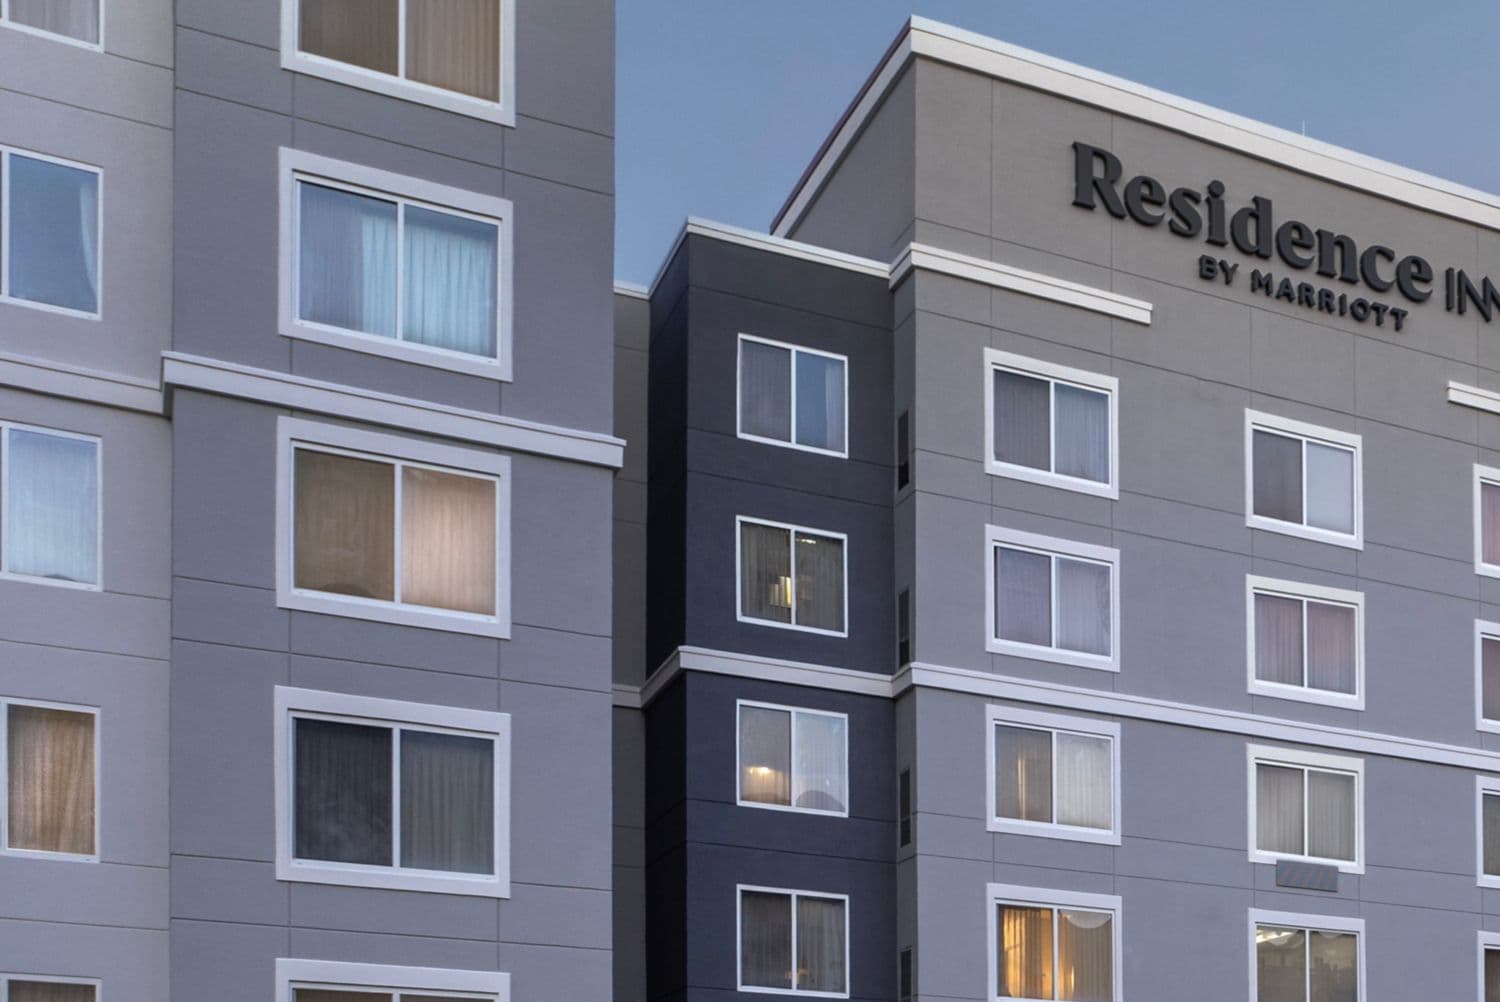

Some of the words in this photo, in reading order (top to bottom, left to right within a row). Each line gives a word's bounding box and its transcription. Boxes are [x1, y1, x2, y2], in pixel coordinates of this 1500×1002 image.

[1072, 141, 1434, 302] Residence
[1199, 255, 1239, 286] BY
[1251, 269, 1409, 332] MARRIOTT
